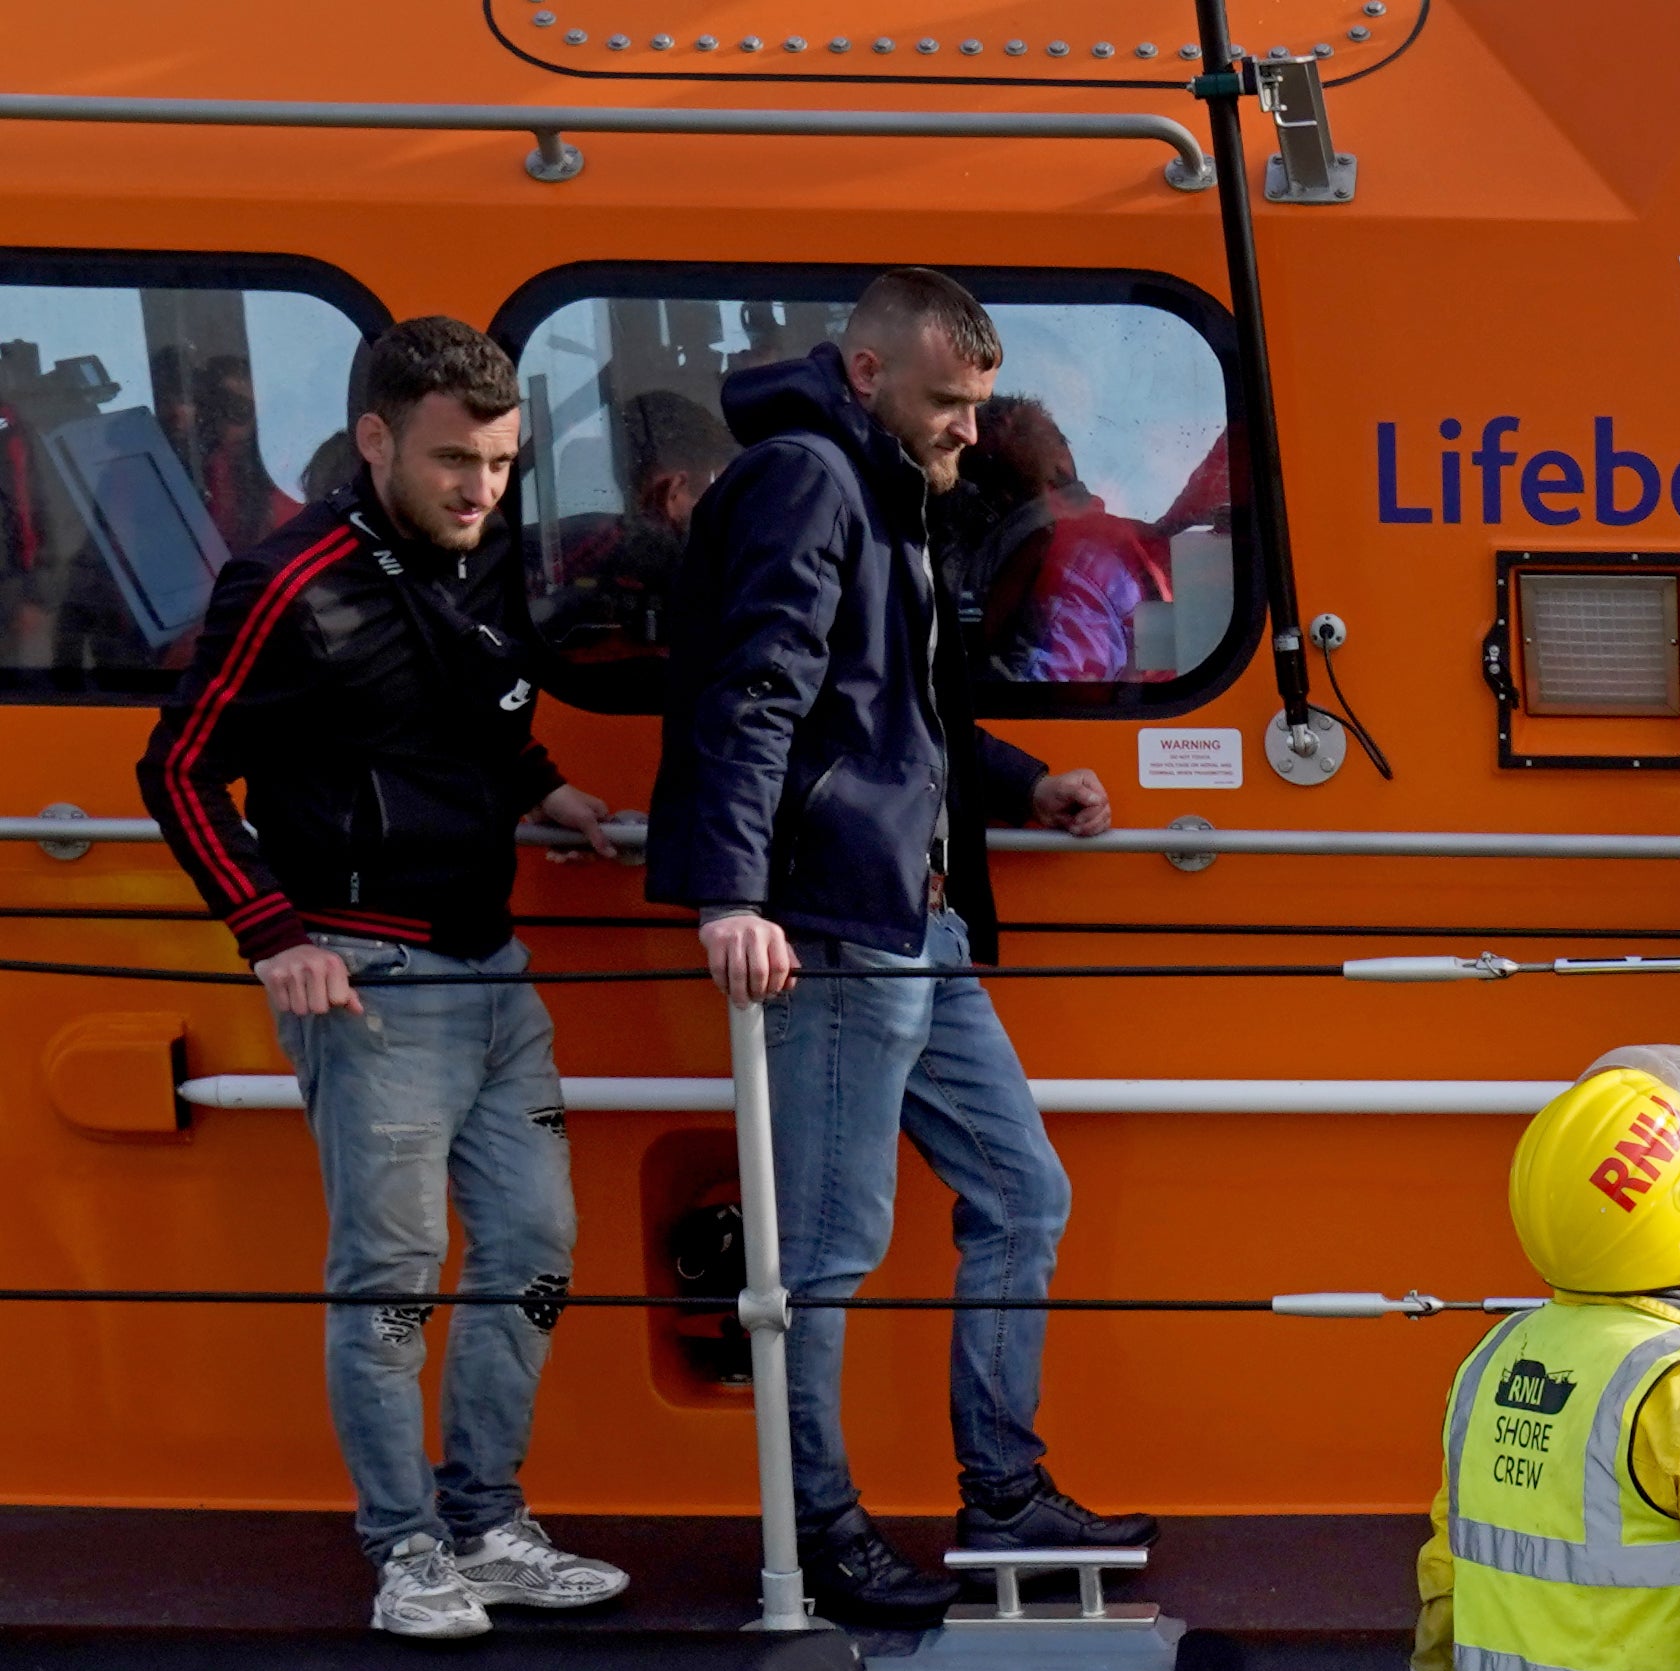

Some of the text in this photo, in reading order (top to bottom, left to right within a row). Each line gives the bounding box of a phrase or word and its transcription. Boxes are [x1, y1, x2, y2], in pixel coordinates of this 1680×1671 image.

[1160, 739, 1222, 751] WARNING
[1508, 1374, 1546, 1406] RNLI
[1494, 1415, 1553, 1453] SHORE
[1493, 1453, 1544, 1491] CREW
